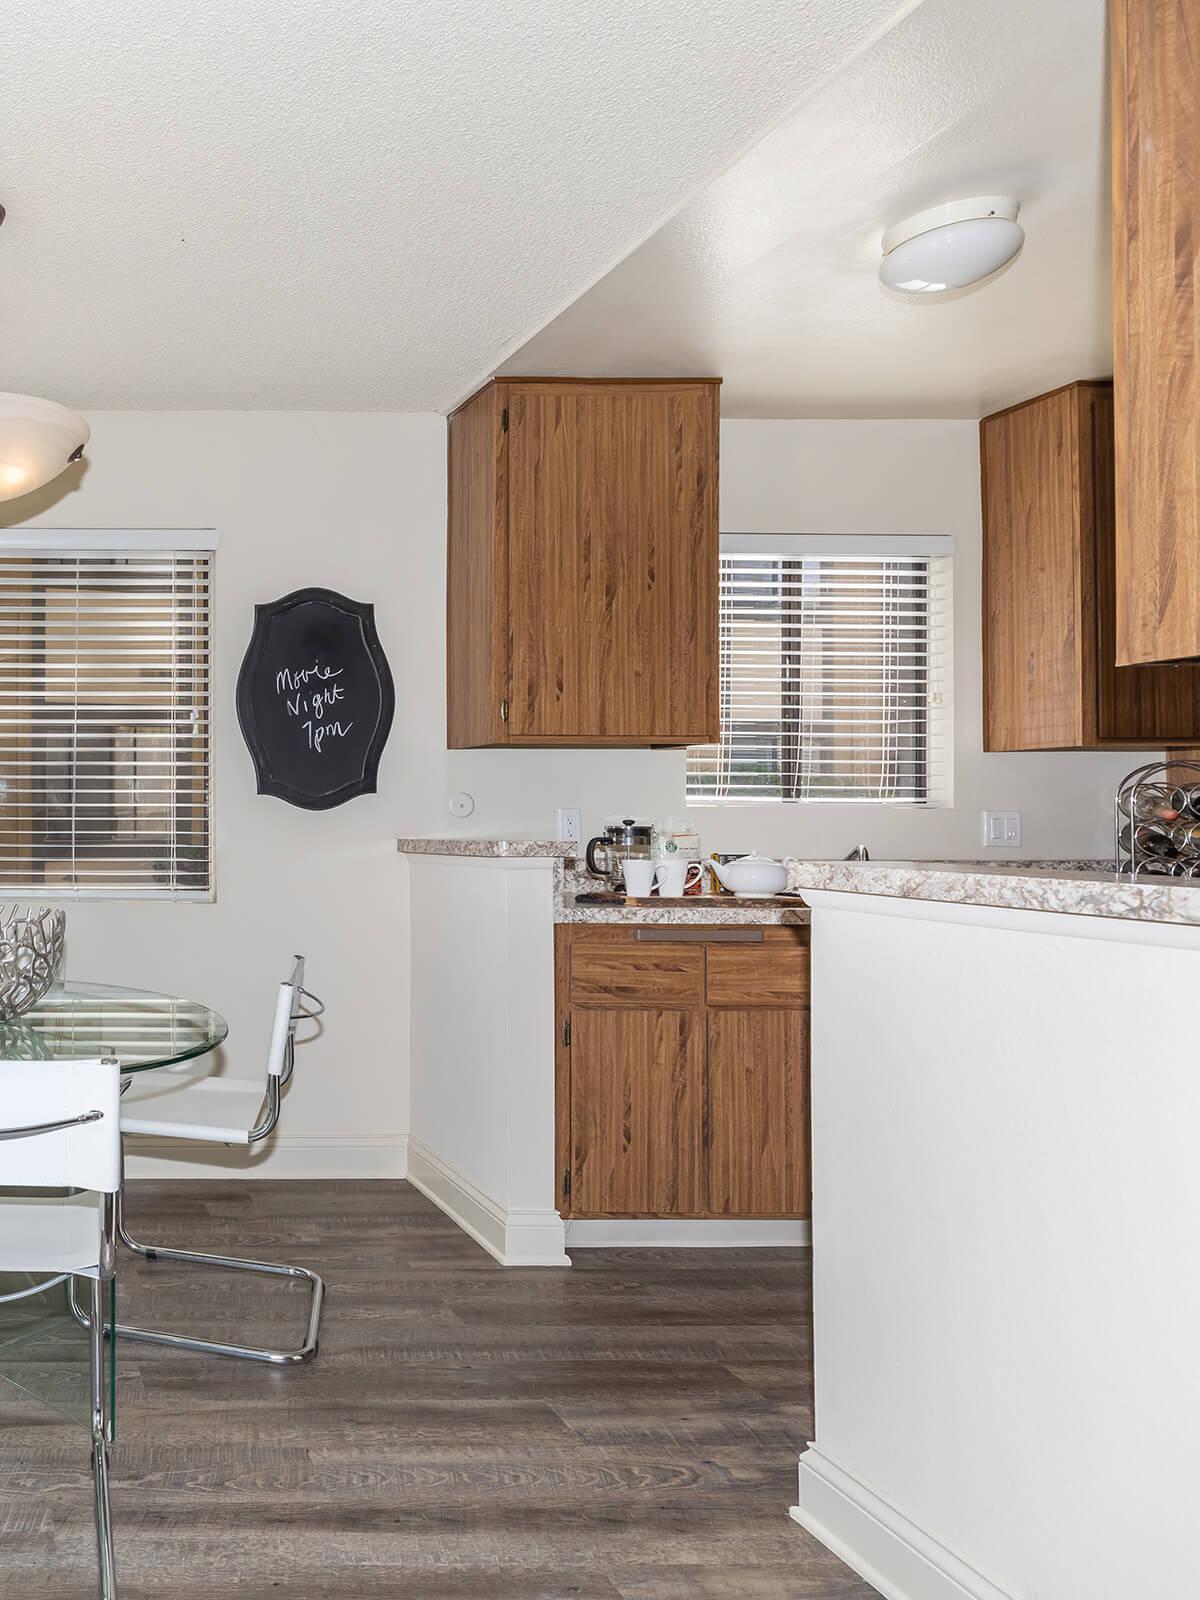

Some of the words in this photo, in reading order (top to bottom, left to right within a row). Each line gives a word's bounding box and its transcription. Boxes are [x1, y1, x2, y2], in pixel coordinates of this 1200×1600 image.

[276, 659, 344, 694] Movie
[286, 683, 345, 718] Night
[301, 721, 353, 752] 7pm
